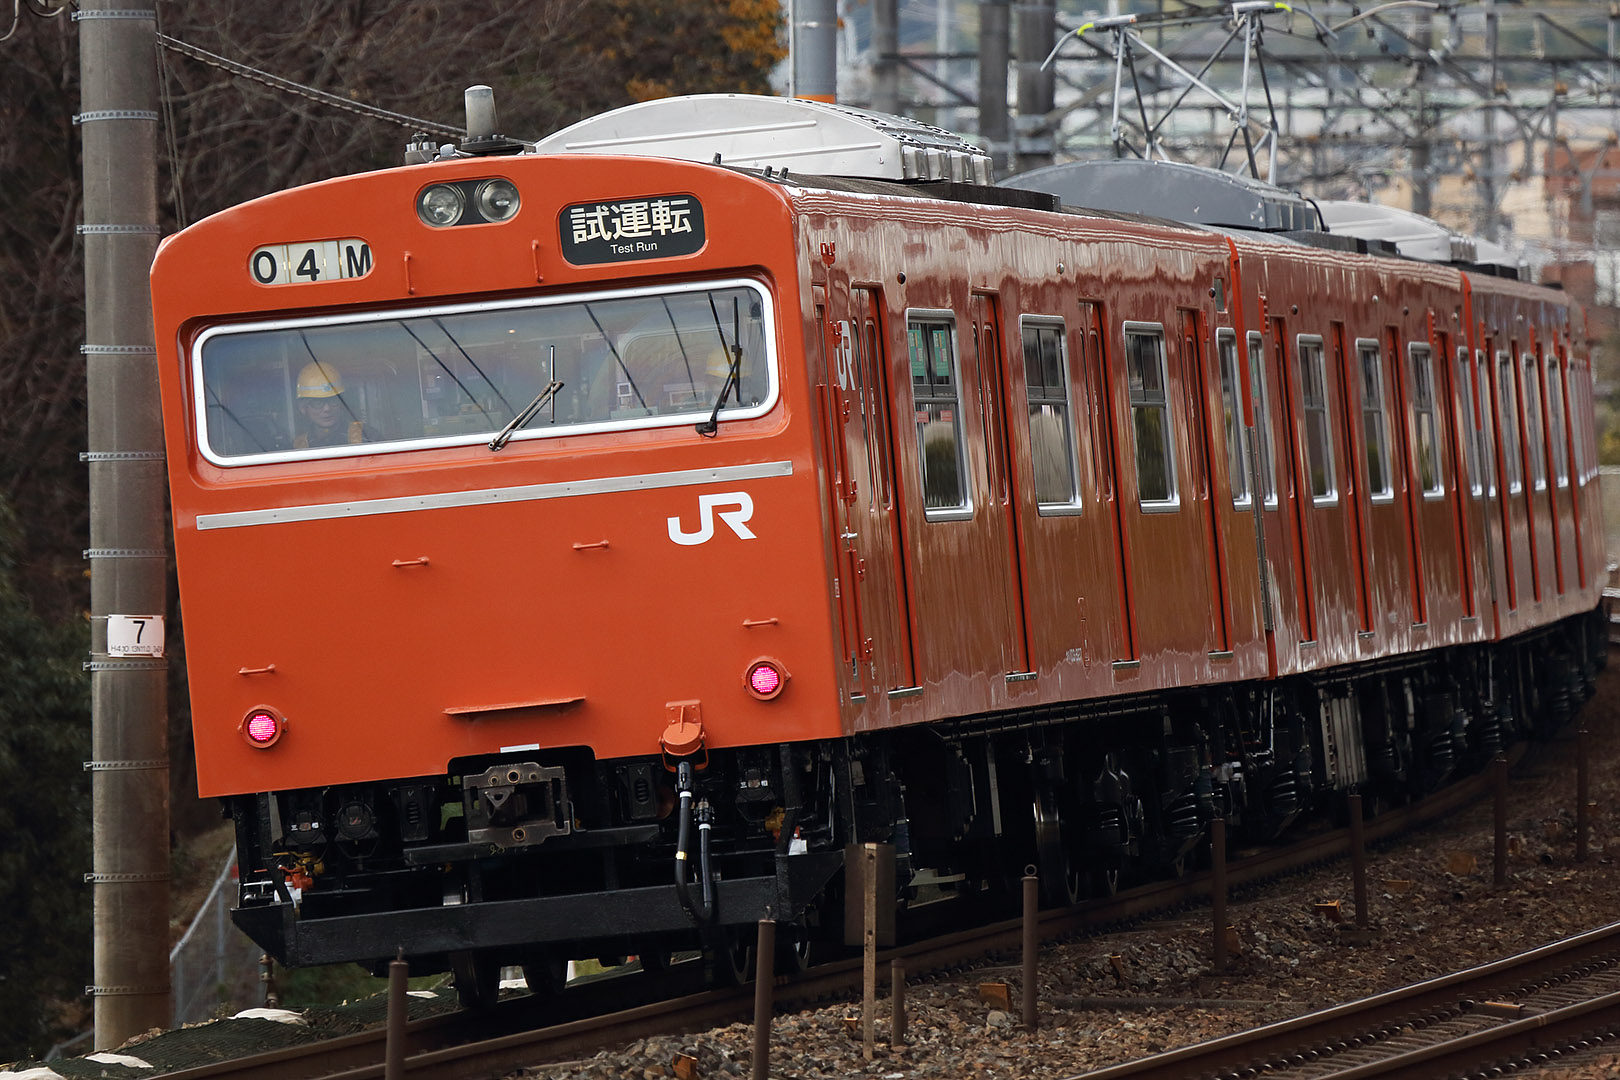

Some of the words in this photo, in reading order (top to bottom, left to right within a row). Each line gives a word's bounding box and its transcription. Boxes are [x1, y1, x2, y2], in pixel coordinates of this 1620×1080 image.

[570, 199, 693, 245] 試運転
[610, 243, 634, 254] Test
[636, 242, 658, 252] Run
[667, 491, 757, 546] JR
[133, 620, 145, 644] 7
